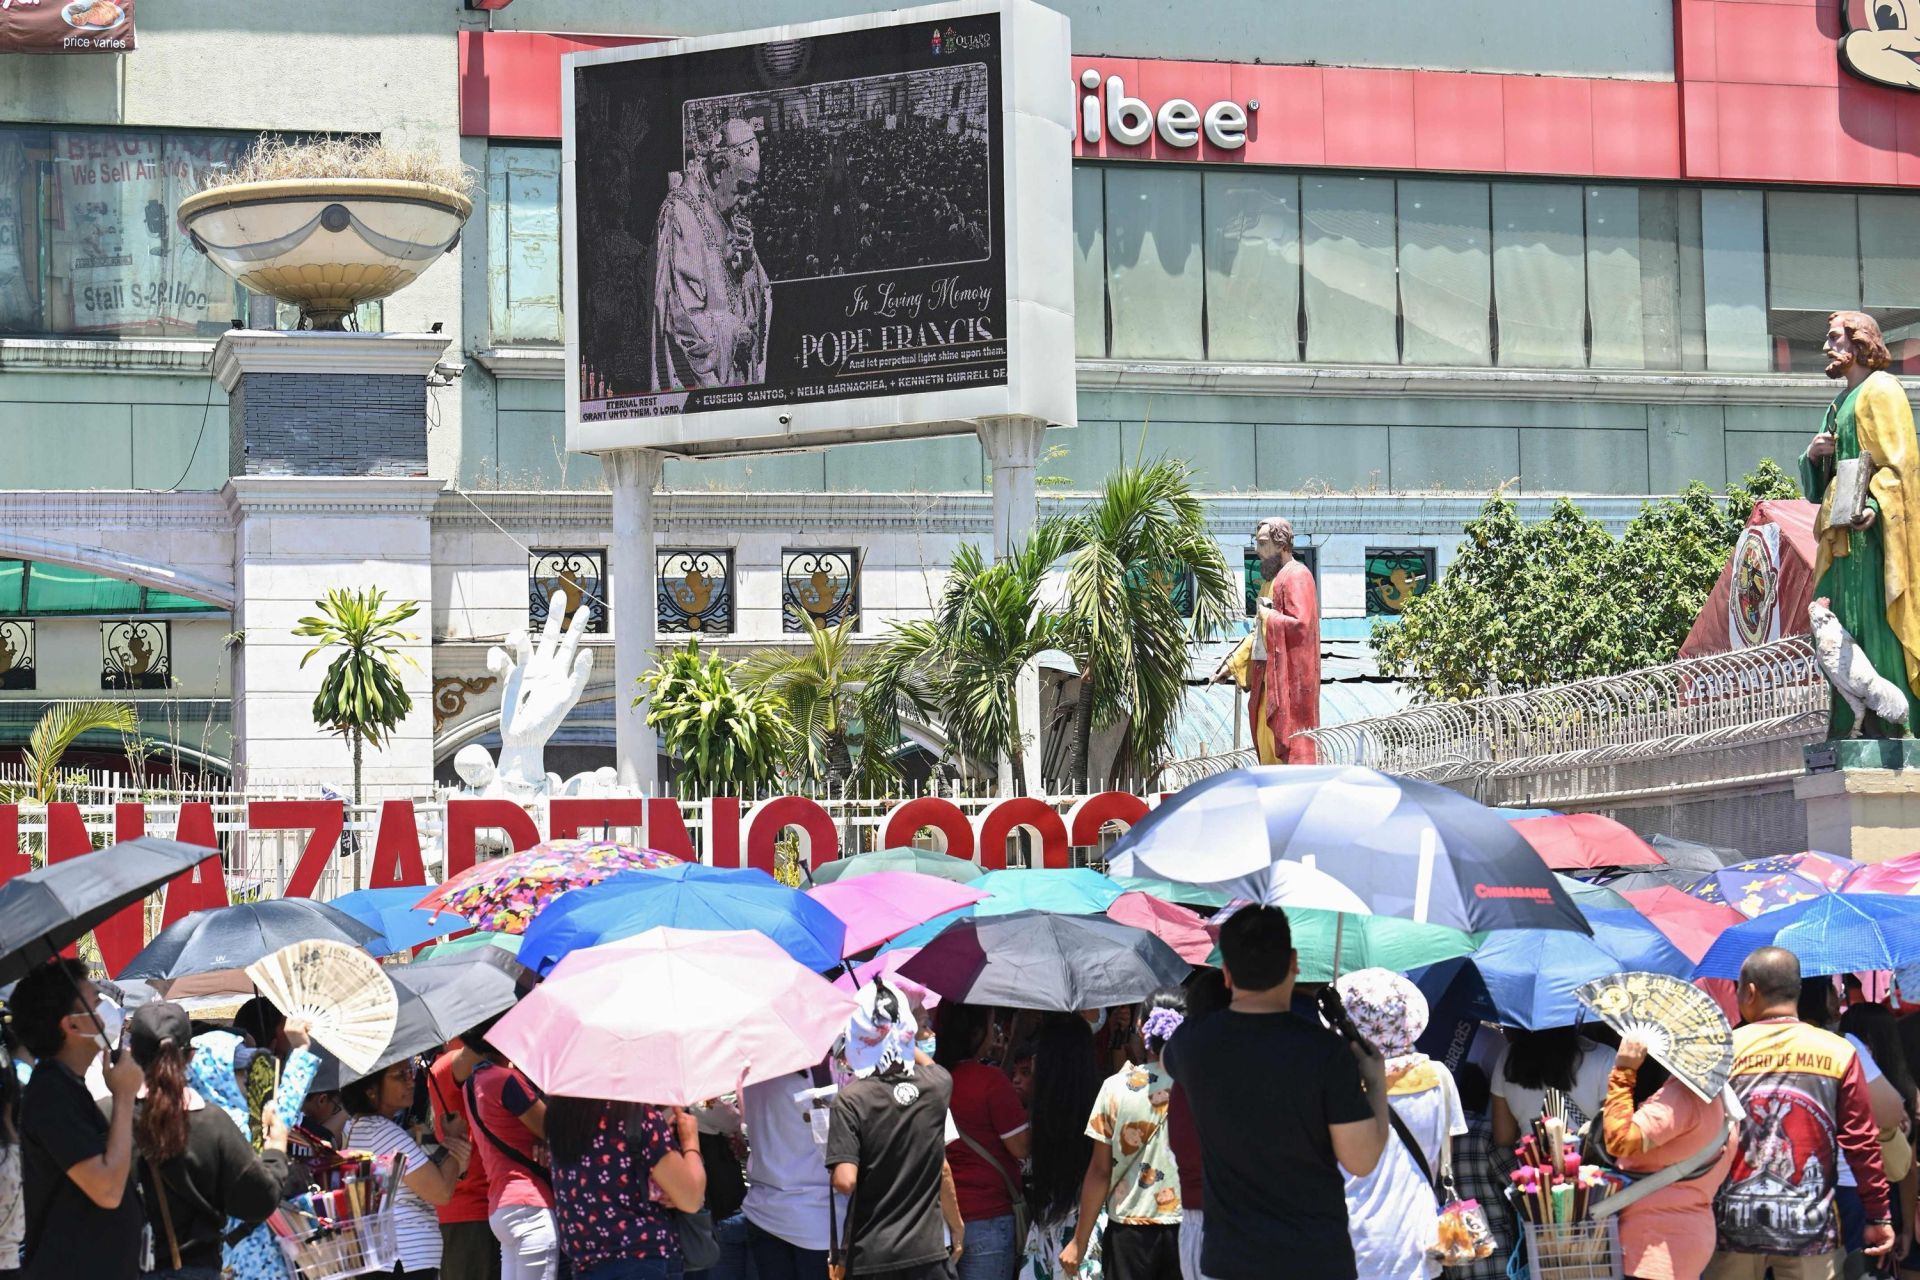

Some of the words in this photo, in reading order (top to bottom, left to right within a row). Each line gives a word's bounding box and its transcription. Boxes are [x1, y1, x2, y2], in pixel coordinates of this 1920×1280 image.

[63, 36, 90, 48] price
[93, 37, 126, 48] varies
[1071, 68, 1248, 149] ibee
[70, 164, 97, 185] We
[100, 160, 131, 183] Sell
[84, 285, 124, 312] Stall
[845, 285, 868, 317] In
[873, 282, 924, 318] Loving
[927, 275, 992, 311] Memory
[802, 328, 872, 369] POPE
[960, 349, 981, 360] upon
[703, 392, 744, 405] EUSEBIO
[797, 385, 825, 397] NELIA
[898, 373, 944, 387] KENNETH
[946, 369, 990, 383] DURRELL
[993, 367, 1007, 379] DE
[582, 411, 607, 421] GRANT
[608, 409, 628, 419] UNTO
[606, 399, 638, 410] ETERNAL
[639, 397, 657, 407] REST
[1776, 1053, 1792, 1068] DE
[1795, 1052, 1833, 1071] MAYO
